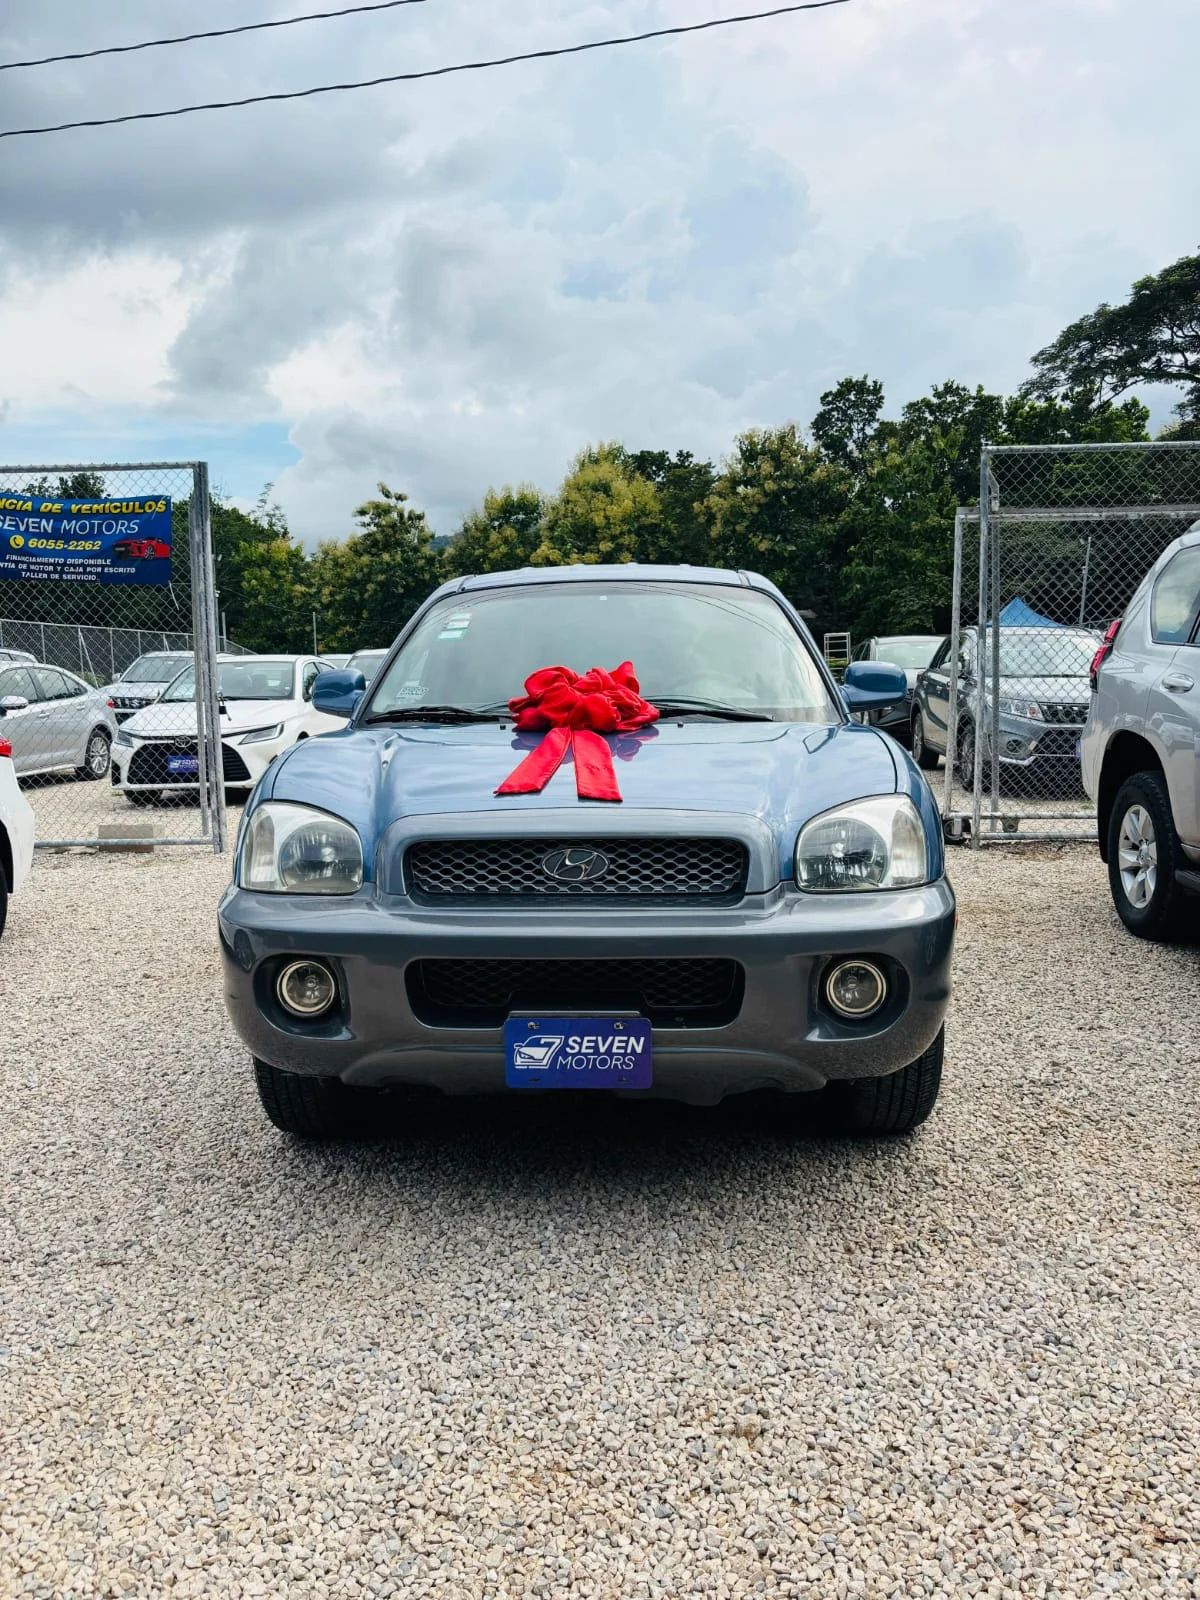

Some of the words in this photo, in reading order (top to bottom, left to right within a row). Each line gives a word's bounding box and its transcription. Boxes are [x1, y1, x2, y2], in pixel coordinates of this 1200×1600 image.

[40, 502, 63, 513] DE
[60, 519, 140, 535] MOTORS
[28, 538, 102, 551] 6055-2262
[21, 571, 48, 579] TALLER
[62, 573, 97, 581] SERVICIO
[565, 1035, 645, 1054] SEVEN
[556, 1055, 635, 1070] MOTORS
